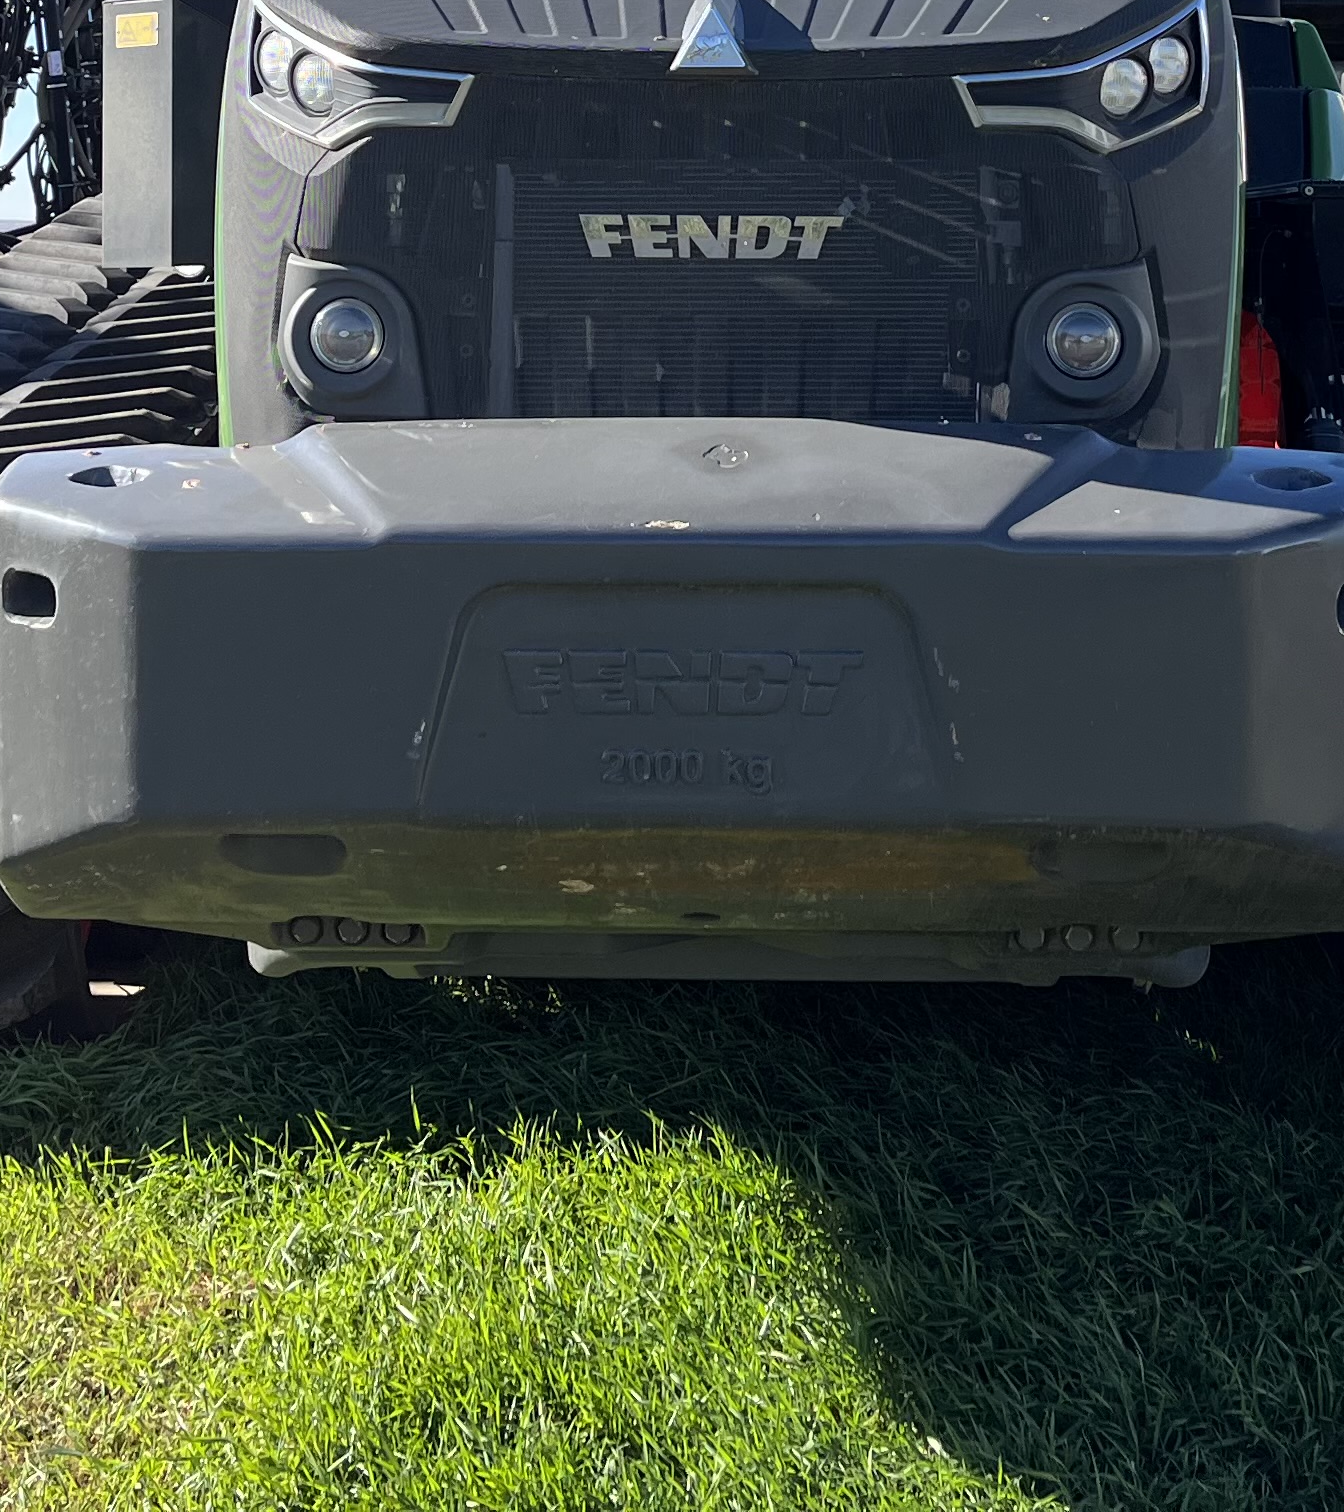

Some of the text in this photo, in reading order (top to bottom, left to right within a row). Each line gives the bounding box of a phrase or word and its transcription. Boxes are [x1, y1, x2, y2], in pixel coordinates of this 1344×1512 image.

[579, 213, 845, 260] FENDT
[502, 649, 864, 716] FENDT
[600, 746, 774, 795] 2000 kg
